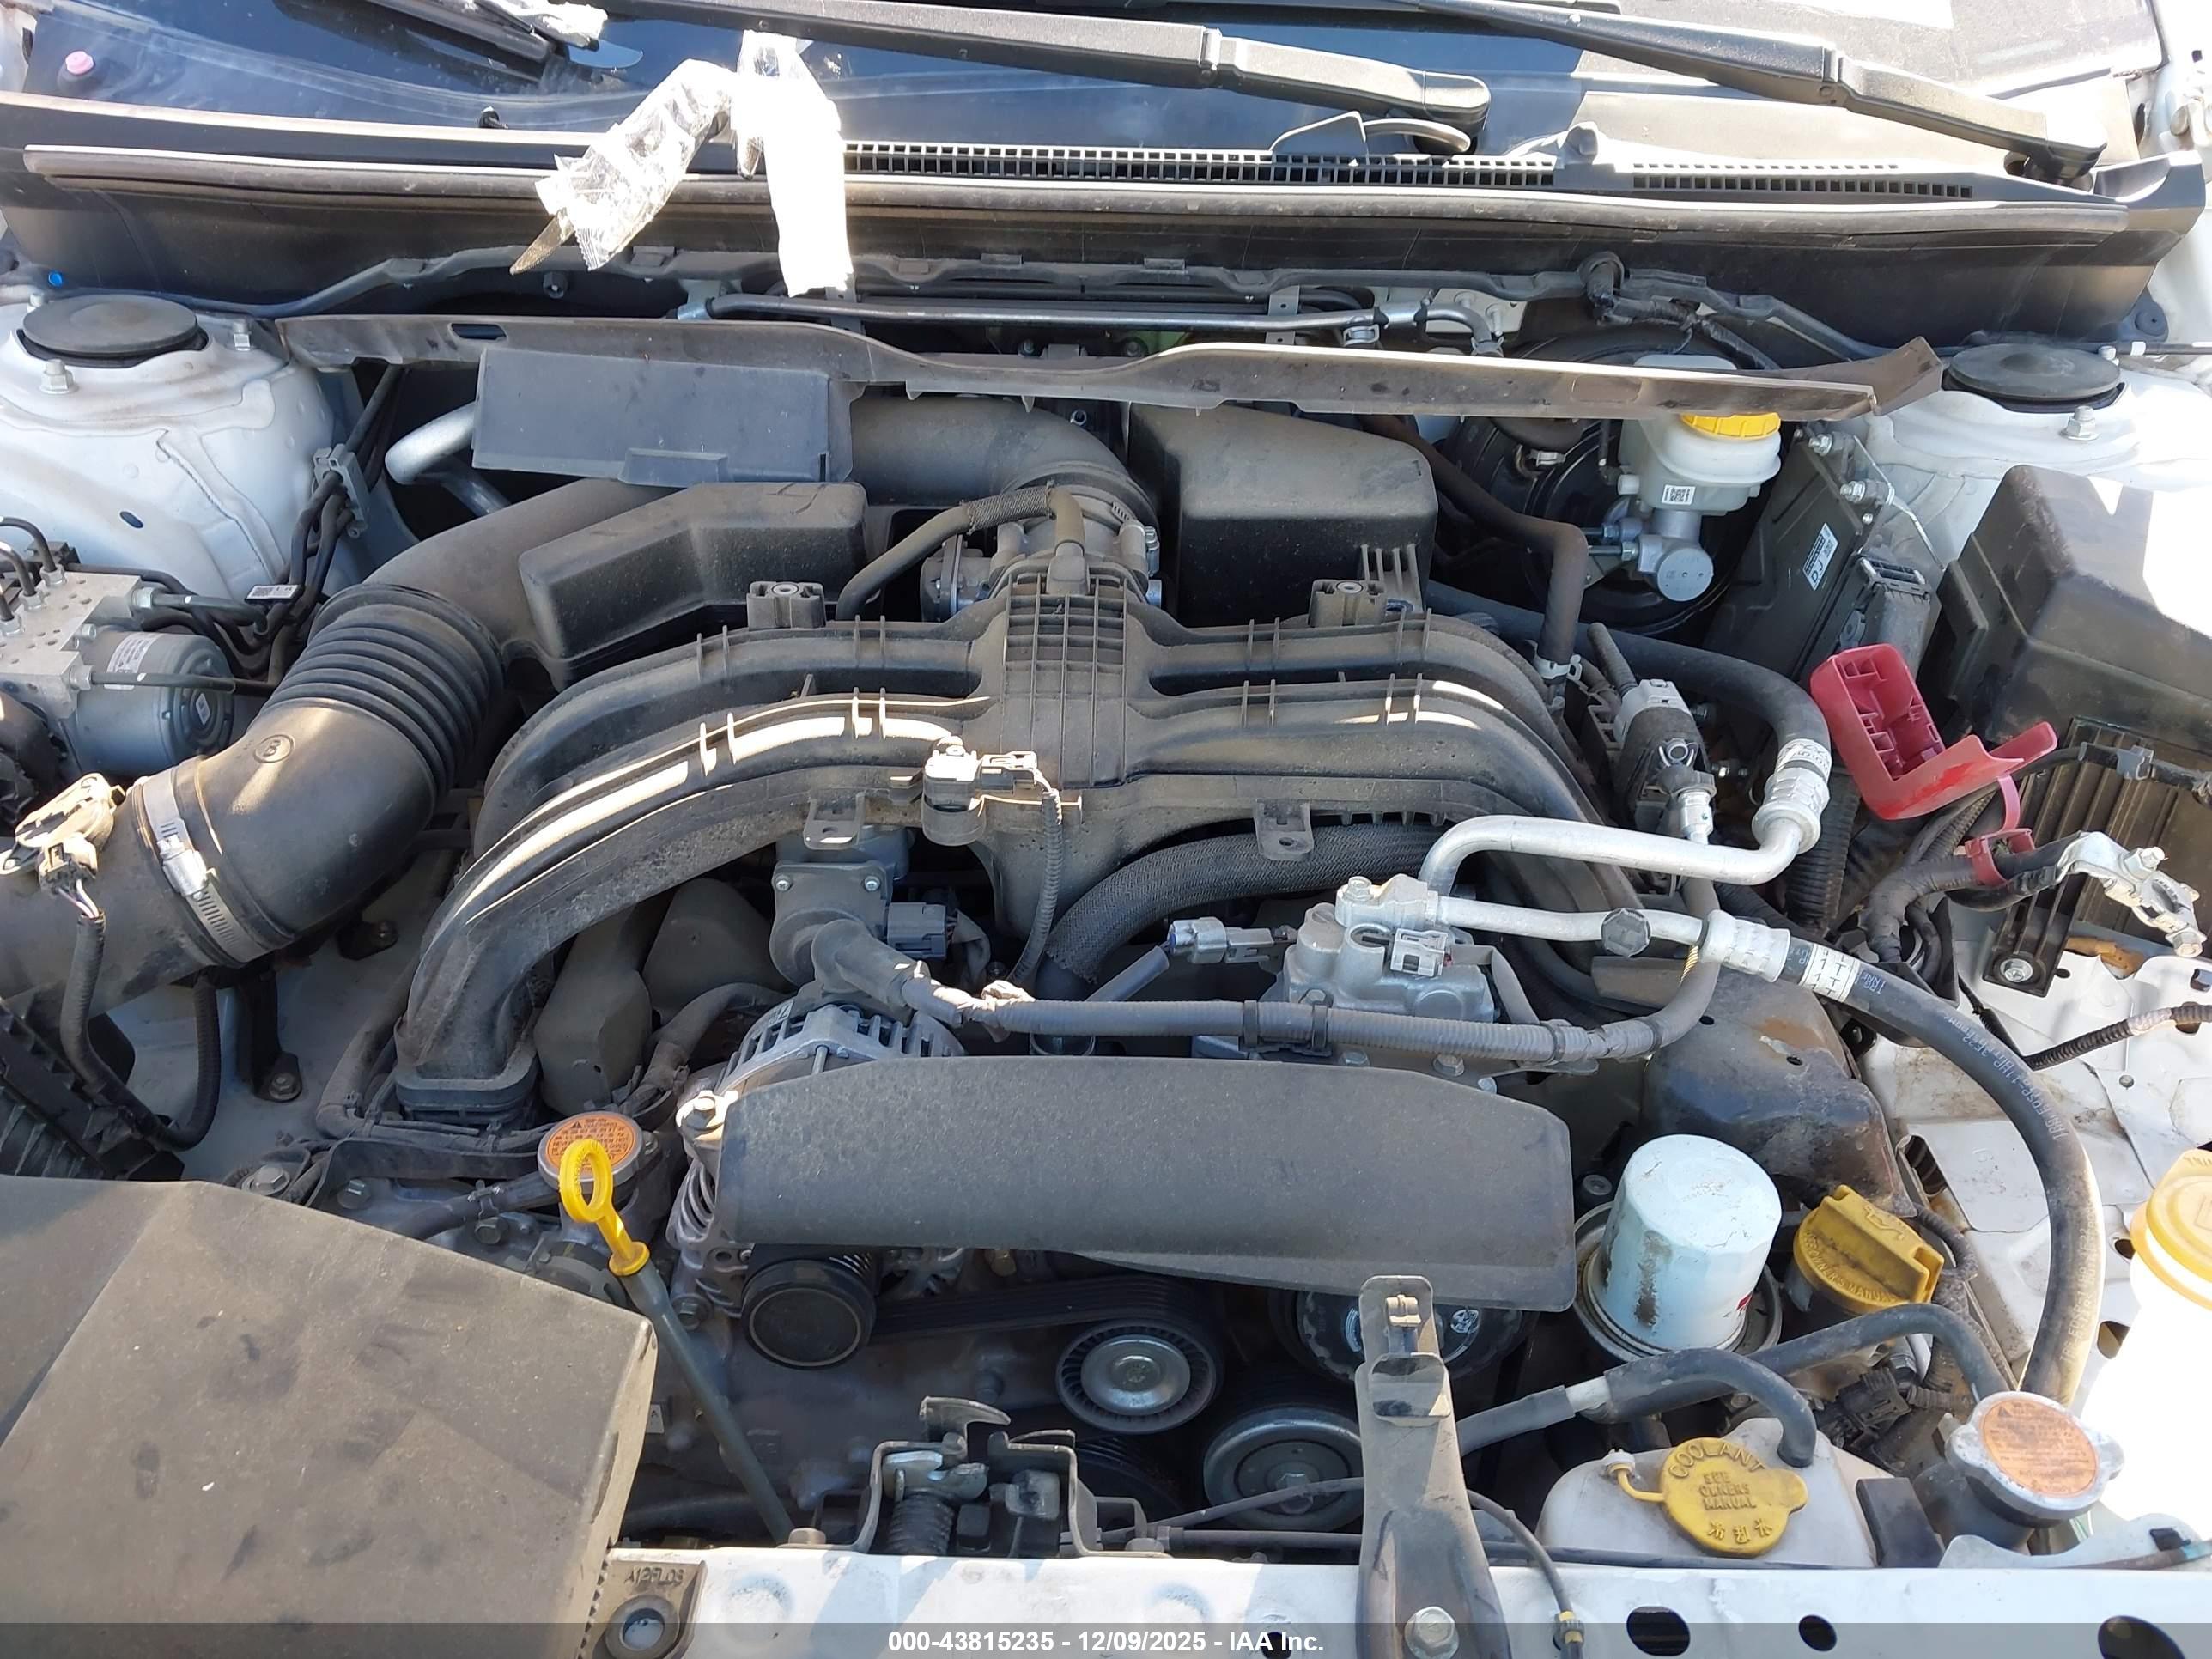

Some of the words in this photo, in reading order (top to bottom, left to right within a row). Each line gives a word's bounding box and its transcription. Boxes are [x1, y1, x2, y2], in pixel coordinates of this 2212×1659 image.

[1668, 1443, 1765, 1479] COOLANT
[1704, 1471, 1732, 1484] SEE
[1702, 1496, 1757, 1510] MANUAL
